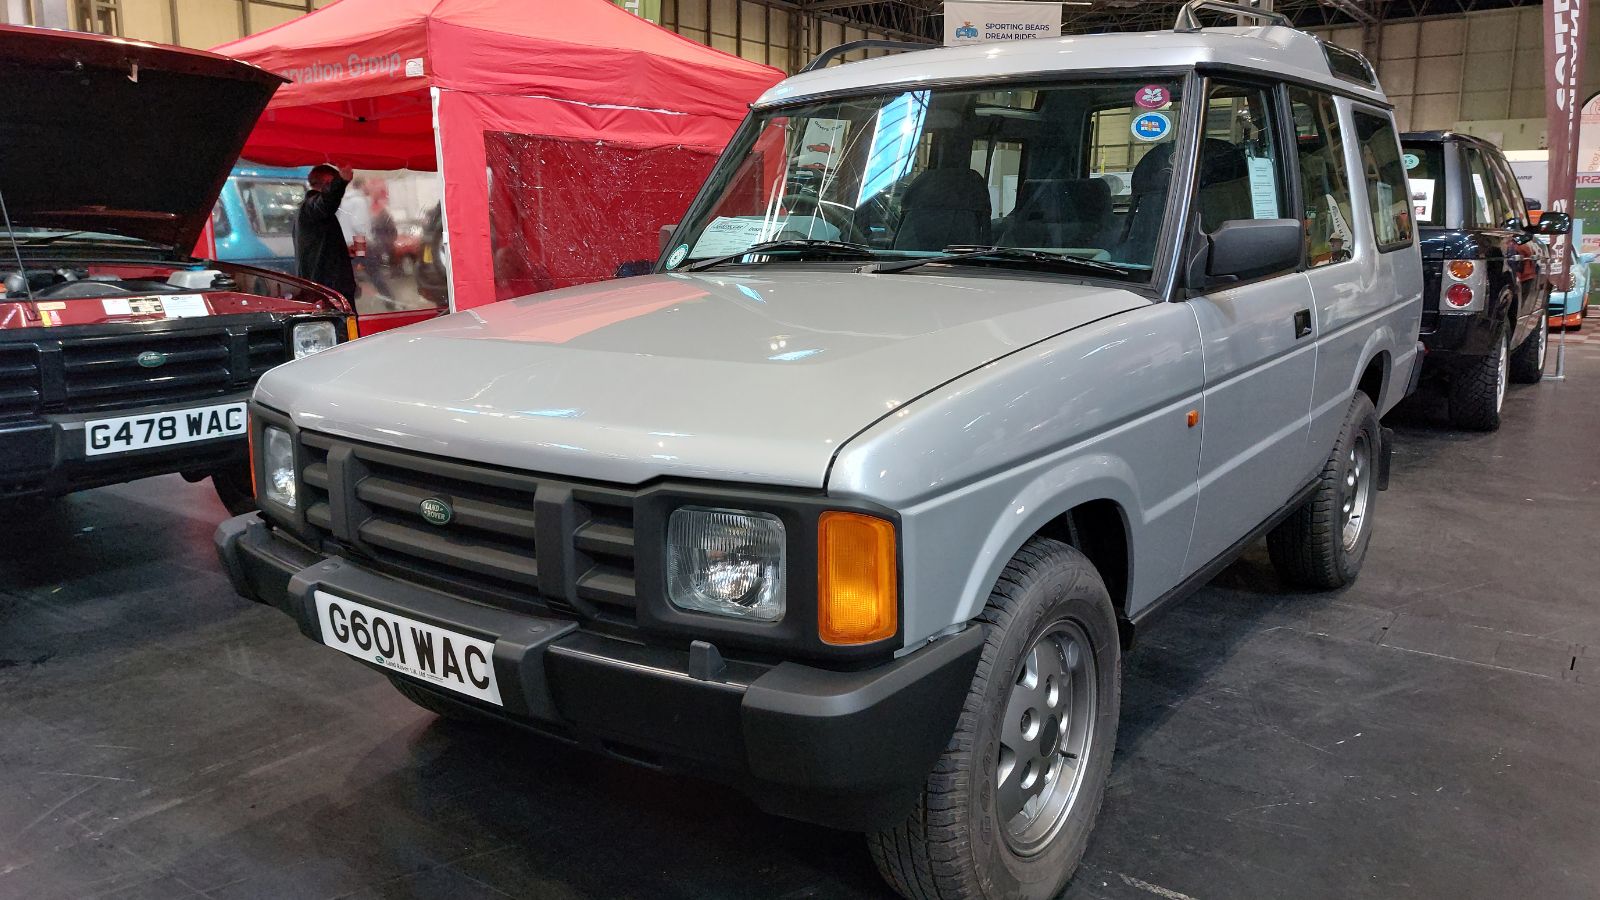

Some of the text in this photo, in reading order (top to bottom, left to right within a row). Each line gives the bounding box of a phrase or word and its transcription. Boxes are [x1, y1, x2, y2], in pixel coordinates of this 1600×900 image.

[985, 32, 1013, 40] DREAM
[347, 52, 401, 78] Group
[91, 407, 243, 450] G478 WAC
[328, 602, 490, 690] G601 WAC
